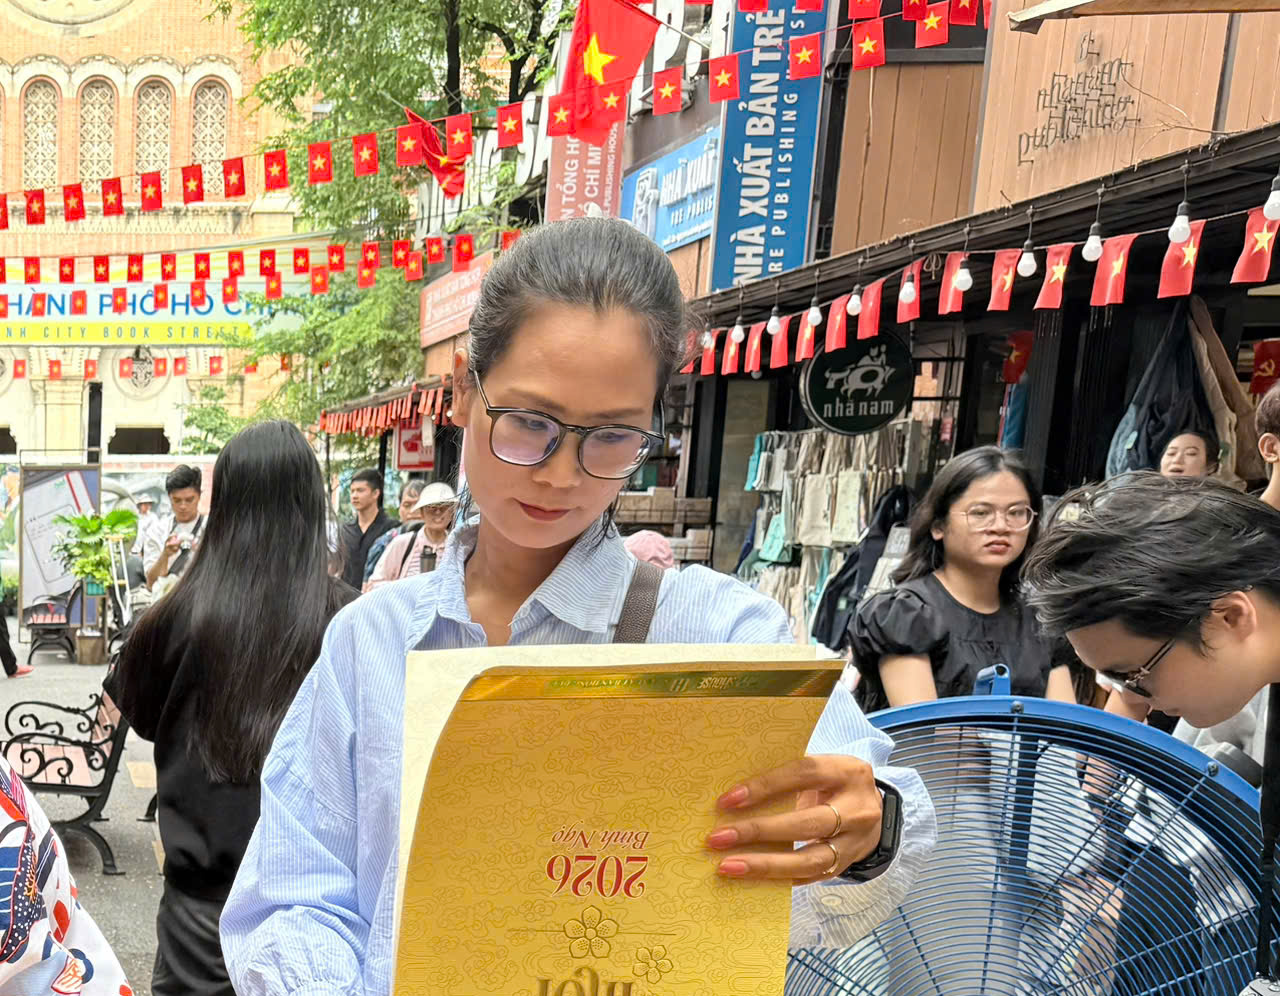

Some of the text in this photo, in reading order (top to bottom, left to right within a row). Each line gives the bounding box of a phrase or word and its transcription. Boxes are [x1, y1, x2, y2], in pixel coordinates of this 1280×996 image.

[738, 72, 780, 137] BẢN
[555, 158, 580, 205] TỔNG
[583, 168, 601, 198] CHÍ
[733, 143, 773, 217] XUẤT
[771, 92, 799, 236] PUBLISHING
[730, 225, 766, 285] NHÀ
[43, 326, 87, 338] CITY
[103, 326, 150, 338] BOOK
[858, 400, 894, 416] nam
[552, 820, 651, 850] Bính Ngọ
[545, 853, 650, 899] 2026
